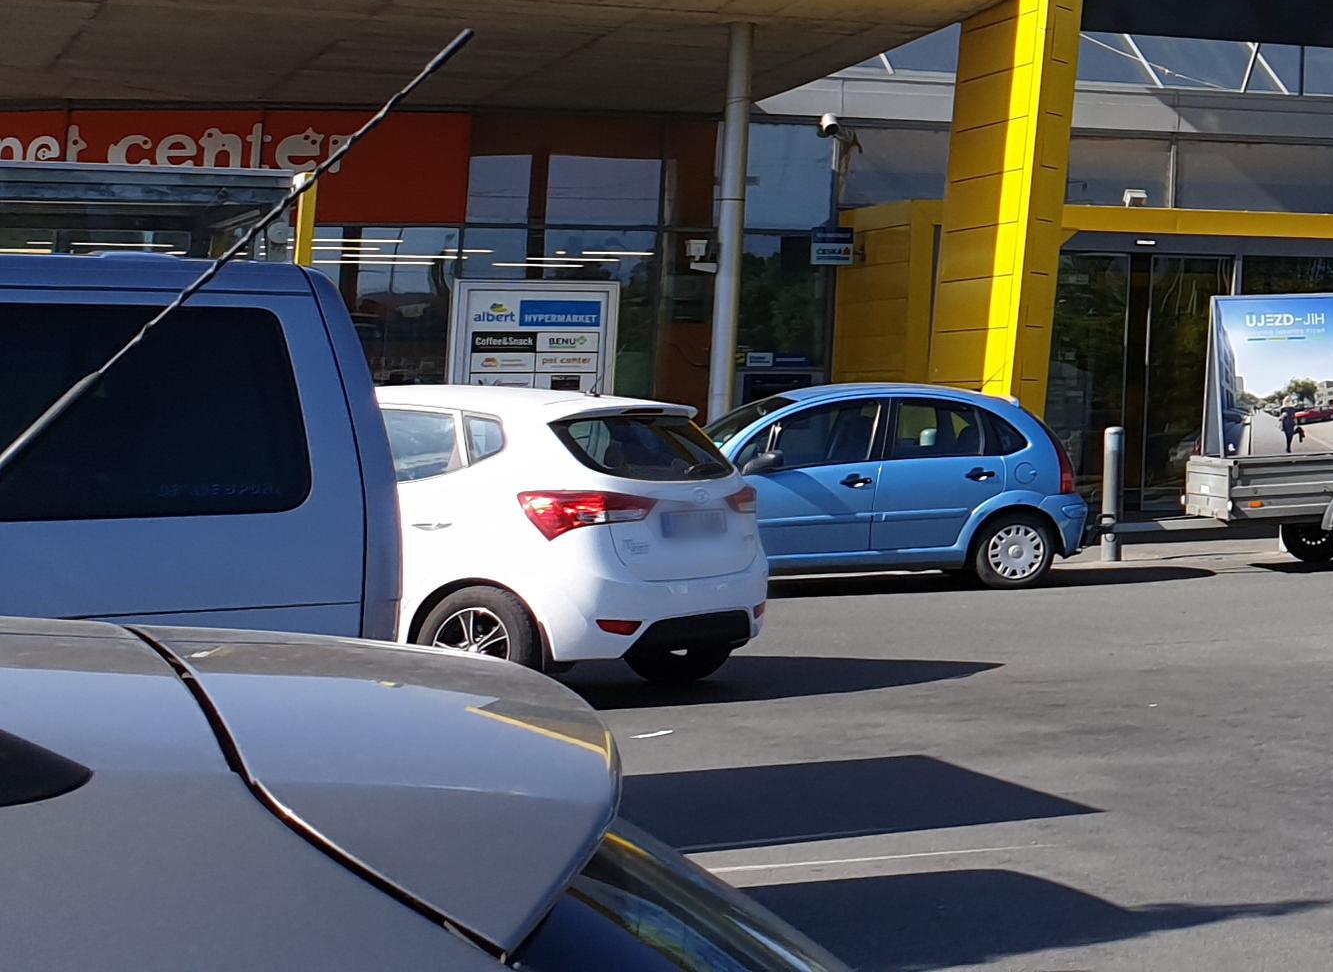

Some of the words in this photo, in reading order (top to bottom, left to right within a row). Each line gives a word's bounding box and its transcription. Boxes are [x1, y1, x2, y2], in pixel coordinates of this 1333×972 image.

[473, 312, 516, 323] albert
[524, 313, 598, 324] HYPERMARKET
[548, 337, 577, 346] BENU
